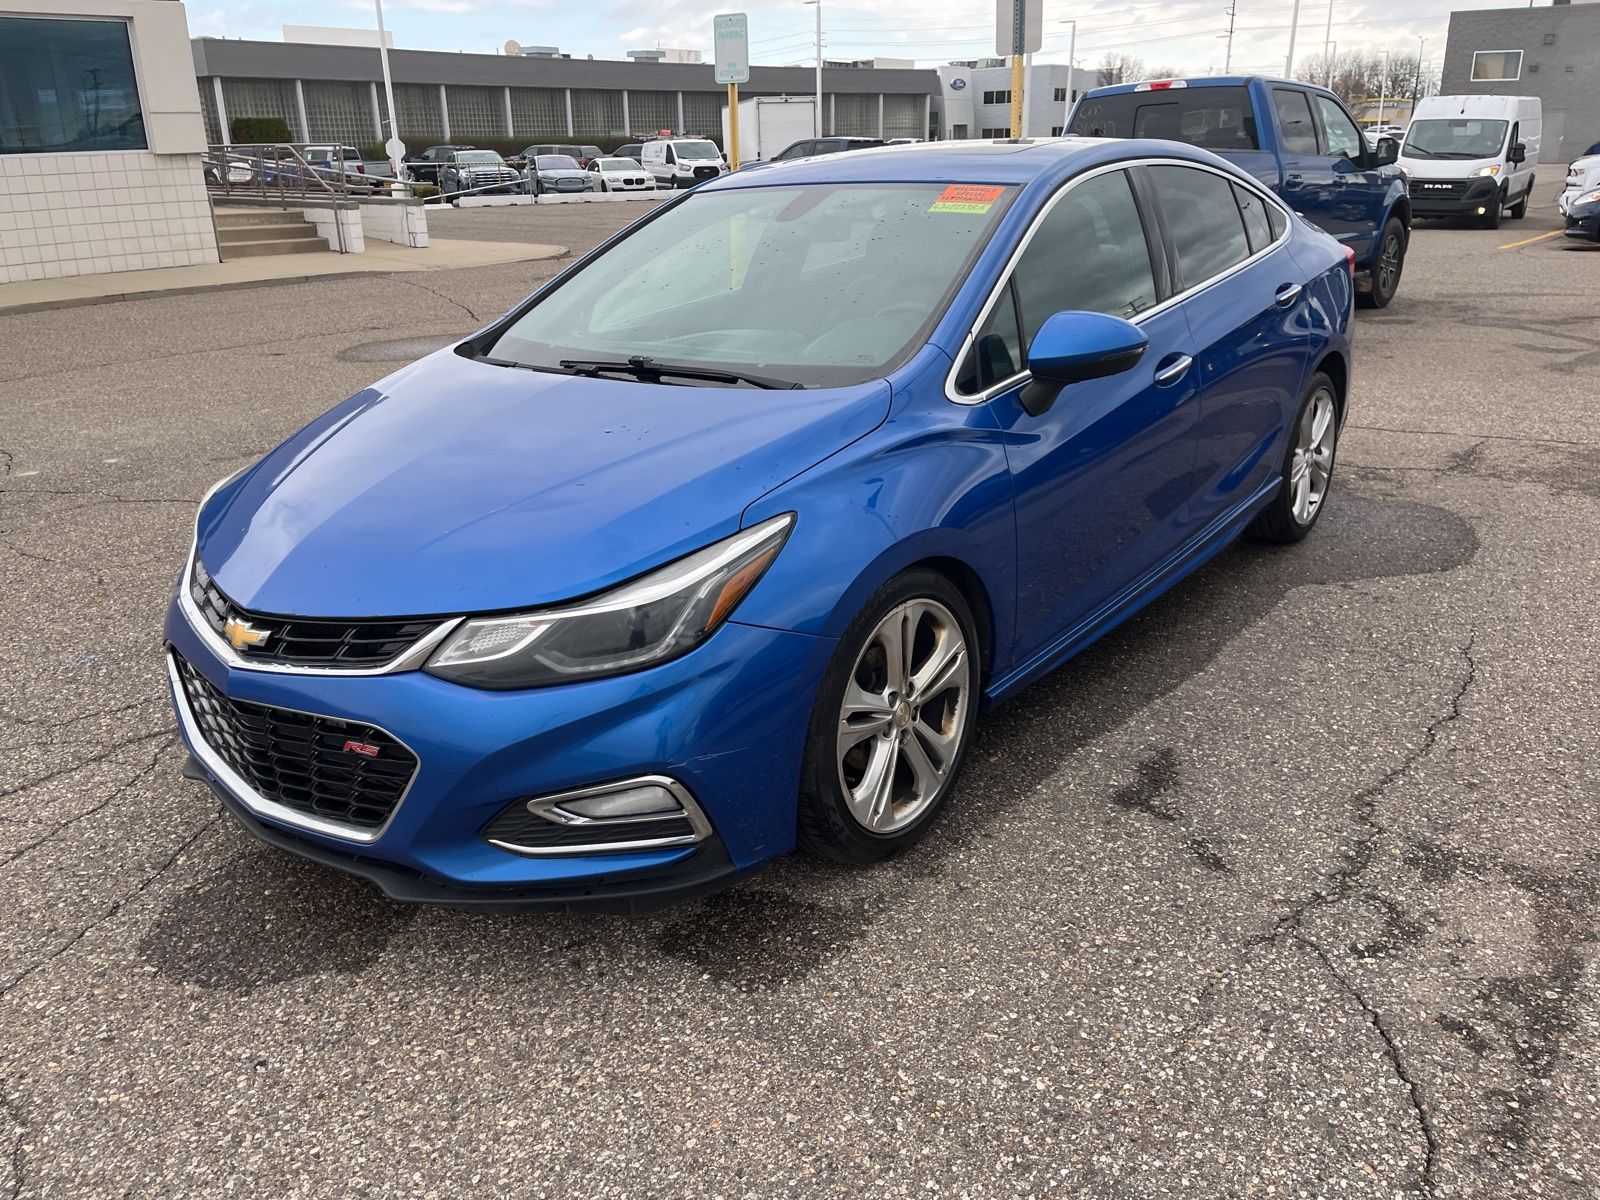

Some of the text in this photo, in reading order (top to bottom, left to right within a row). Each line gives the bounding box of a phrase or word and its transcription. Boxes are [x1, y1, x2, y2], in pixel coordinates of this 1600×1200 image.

[716, 18, 745, 29] RESERVED
[718, 30, 744, 41] PARKING
[343, 740, 380, 757] RS
